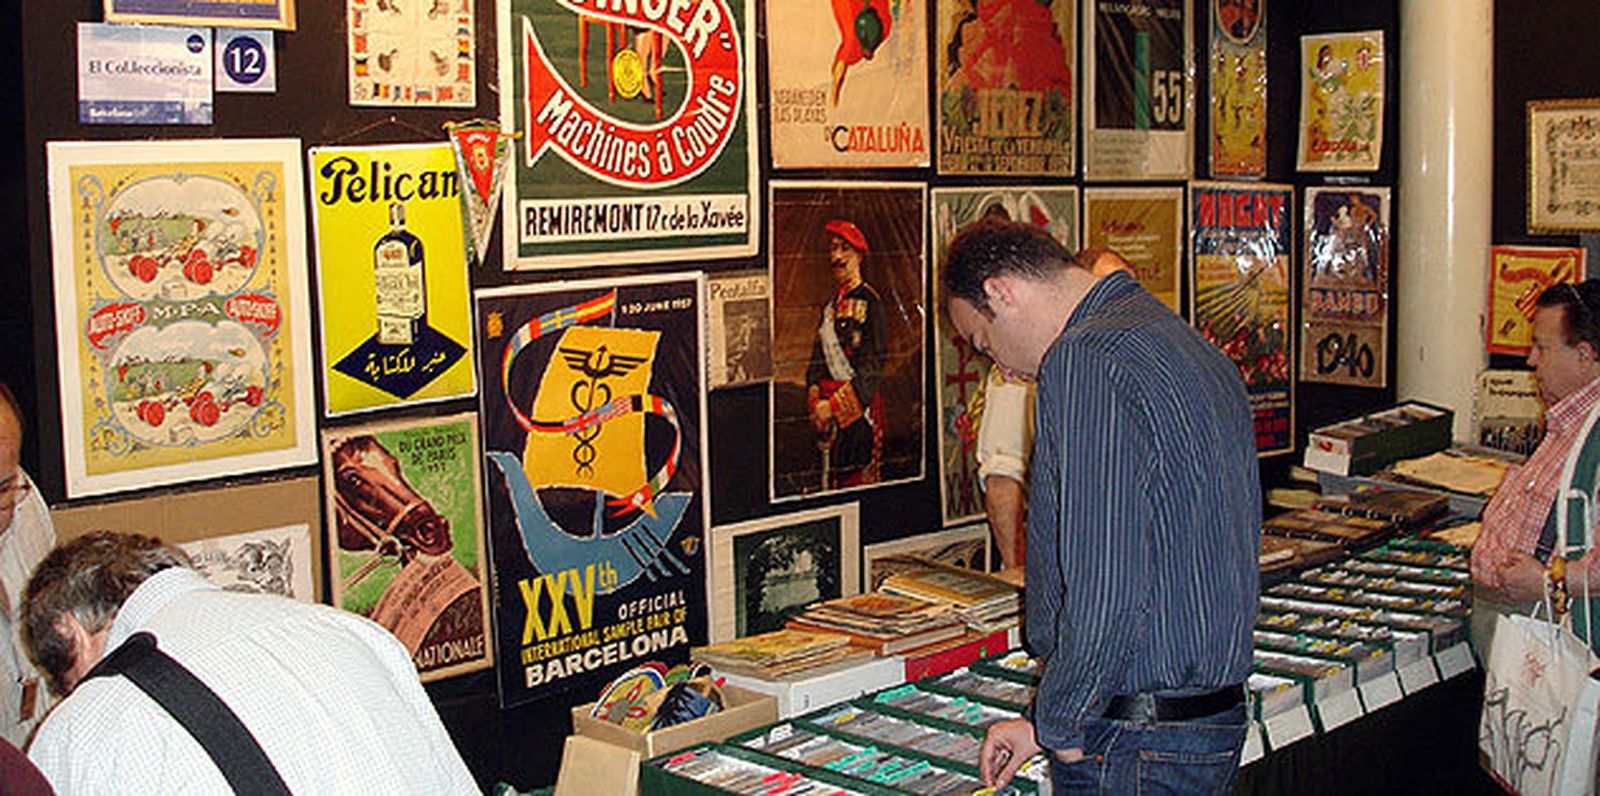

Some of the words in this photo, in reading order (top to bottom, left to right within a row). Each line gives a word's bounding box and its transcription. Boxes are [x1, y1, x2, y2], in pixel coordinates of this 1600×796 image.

[88, 60, 101, 75] El
[229, 47, 262, 74] 12
[1153, 69, 1181, 124] 55
[536, 88, 650, 178] Machines
[671, 74, 736, 167] Coudre
[831, 121, 924, 153] CATALUÑA
[321, 156, 459, 206] Pelican
[525, 203, 643, 237] REMIREMONT
[646, 204, 661, 231] 17
[670, 204, 685, 230] de
[686, 203, 698, 229] la
[699, 200, 744, 229] Xavée
[1200, 193, 1284, 228] NOGAT
[644, 300, 669, 313] JUNE
[414, 434, 445, 451] GRAND
[618, 589, 687, 621] OFFICIAL
[520, 629, 600, 665] INTERNATIONAL
[602, 617, 645, 643] SAMPLE
[646, 613, 670, 631] FAIR
[673, 606, 688, 624] OF
[525, 625, 689, 689] BARCELONA
